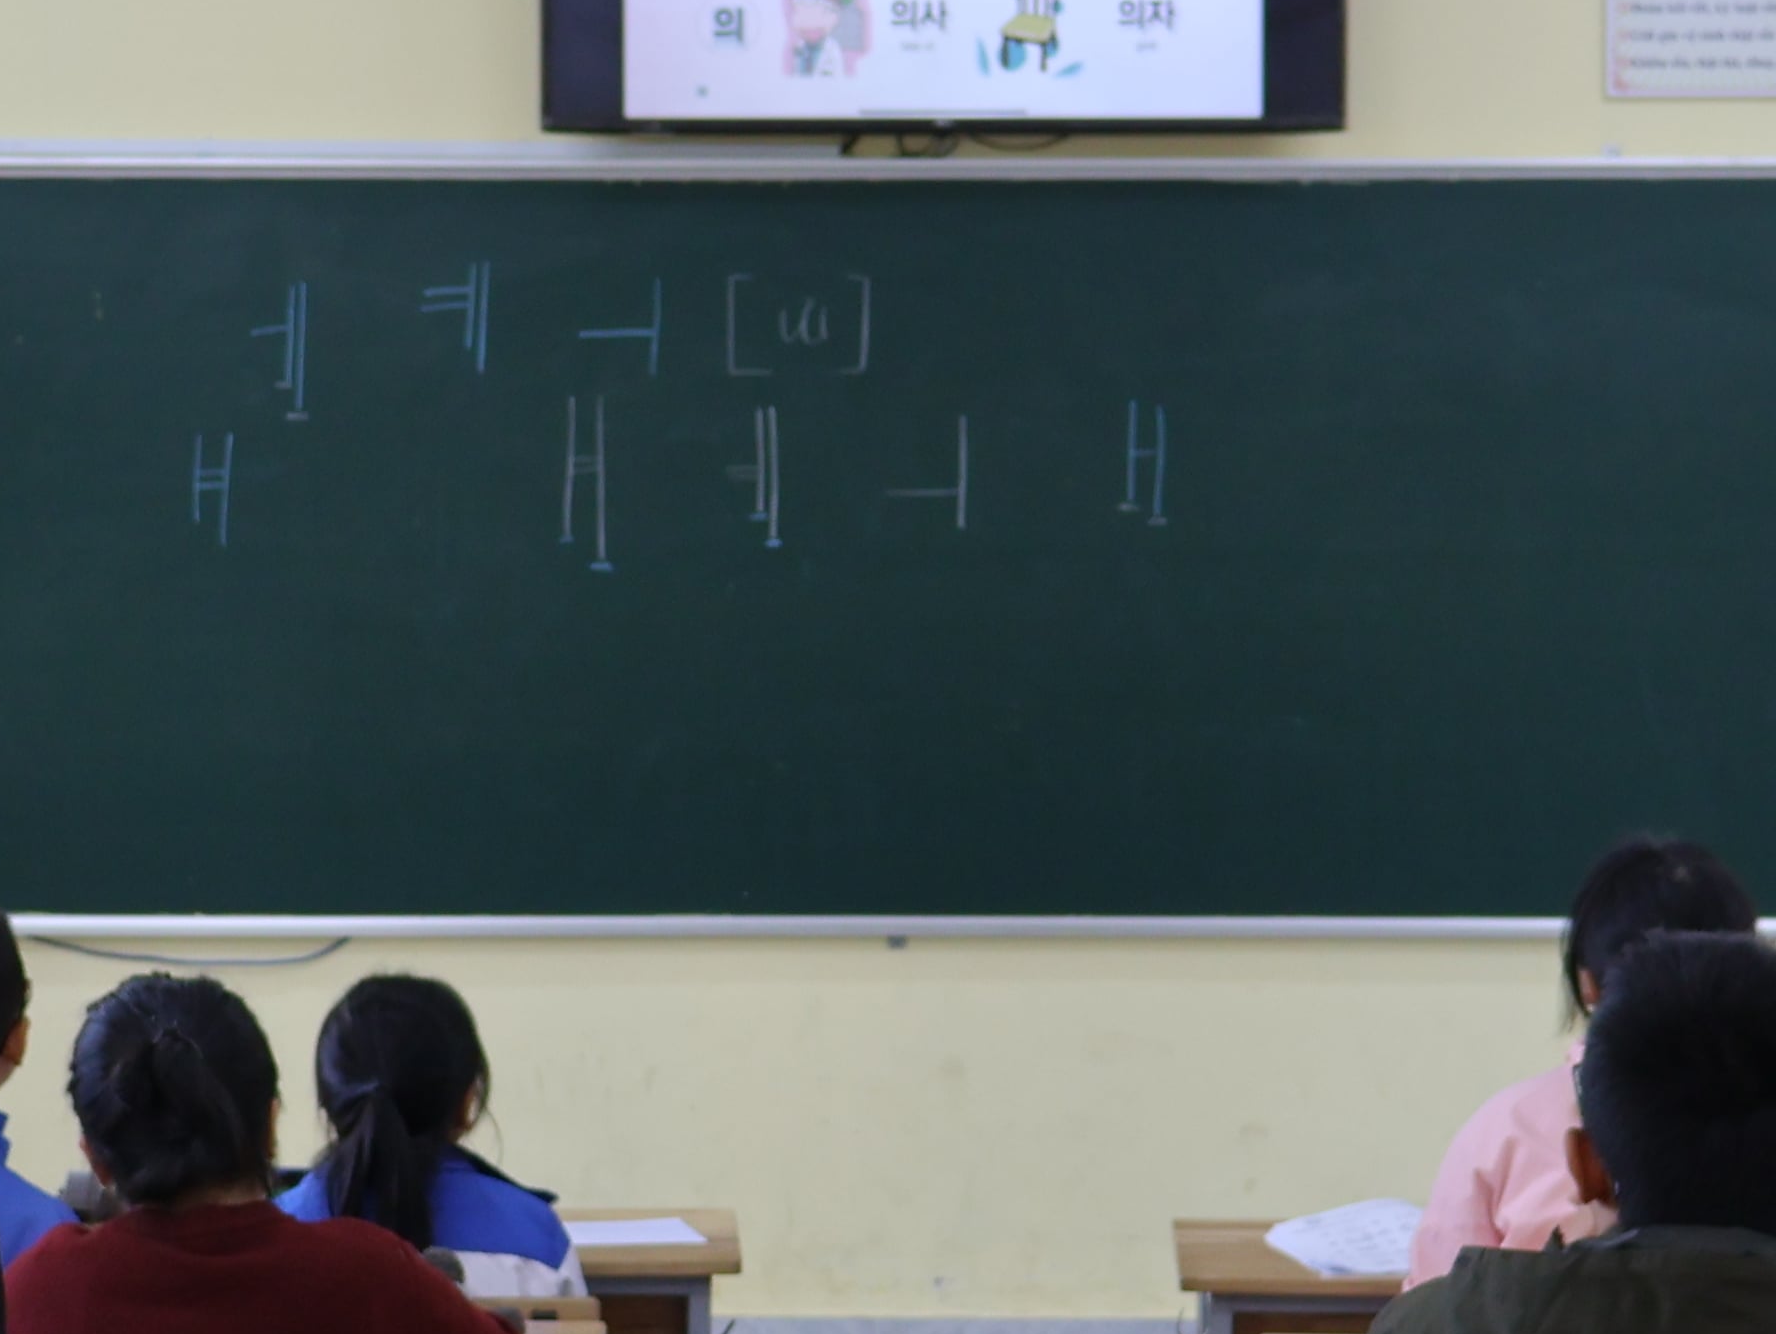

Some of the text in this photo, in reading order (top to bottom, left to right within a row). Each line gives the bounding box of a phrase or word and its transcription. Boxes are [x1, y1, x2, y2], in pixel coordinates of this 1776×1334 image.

[712, 8, 744, 44] 의
[890, 0, 948, 31] 의사
[1117, 0, 1176, 31] 의자
